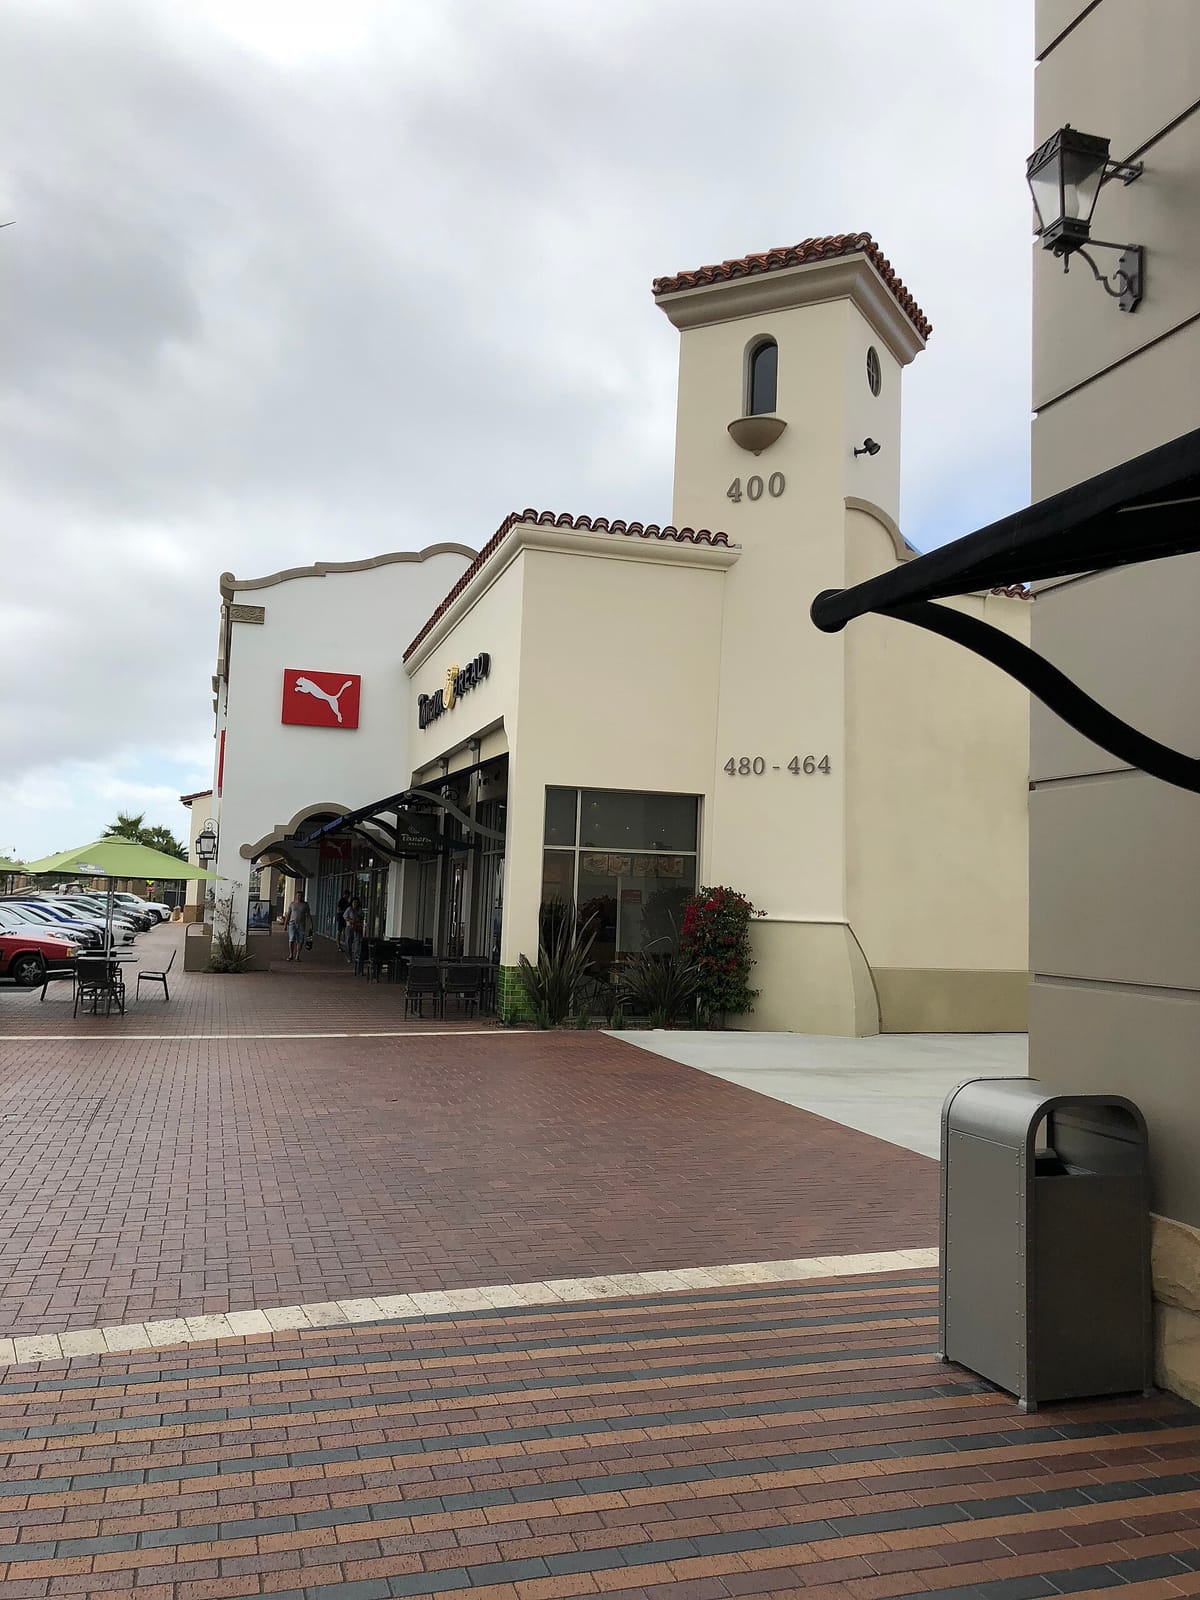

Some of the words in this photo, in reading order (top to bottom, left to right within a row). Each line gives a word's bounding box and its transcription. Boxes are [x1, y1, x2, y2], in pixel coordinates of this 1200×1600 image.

[727, 471, 785, 503] 400
[723, 756, 765, 776] 480
[787, 754, 831, 775] 464
